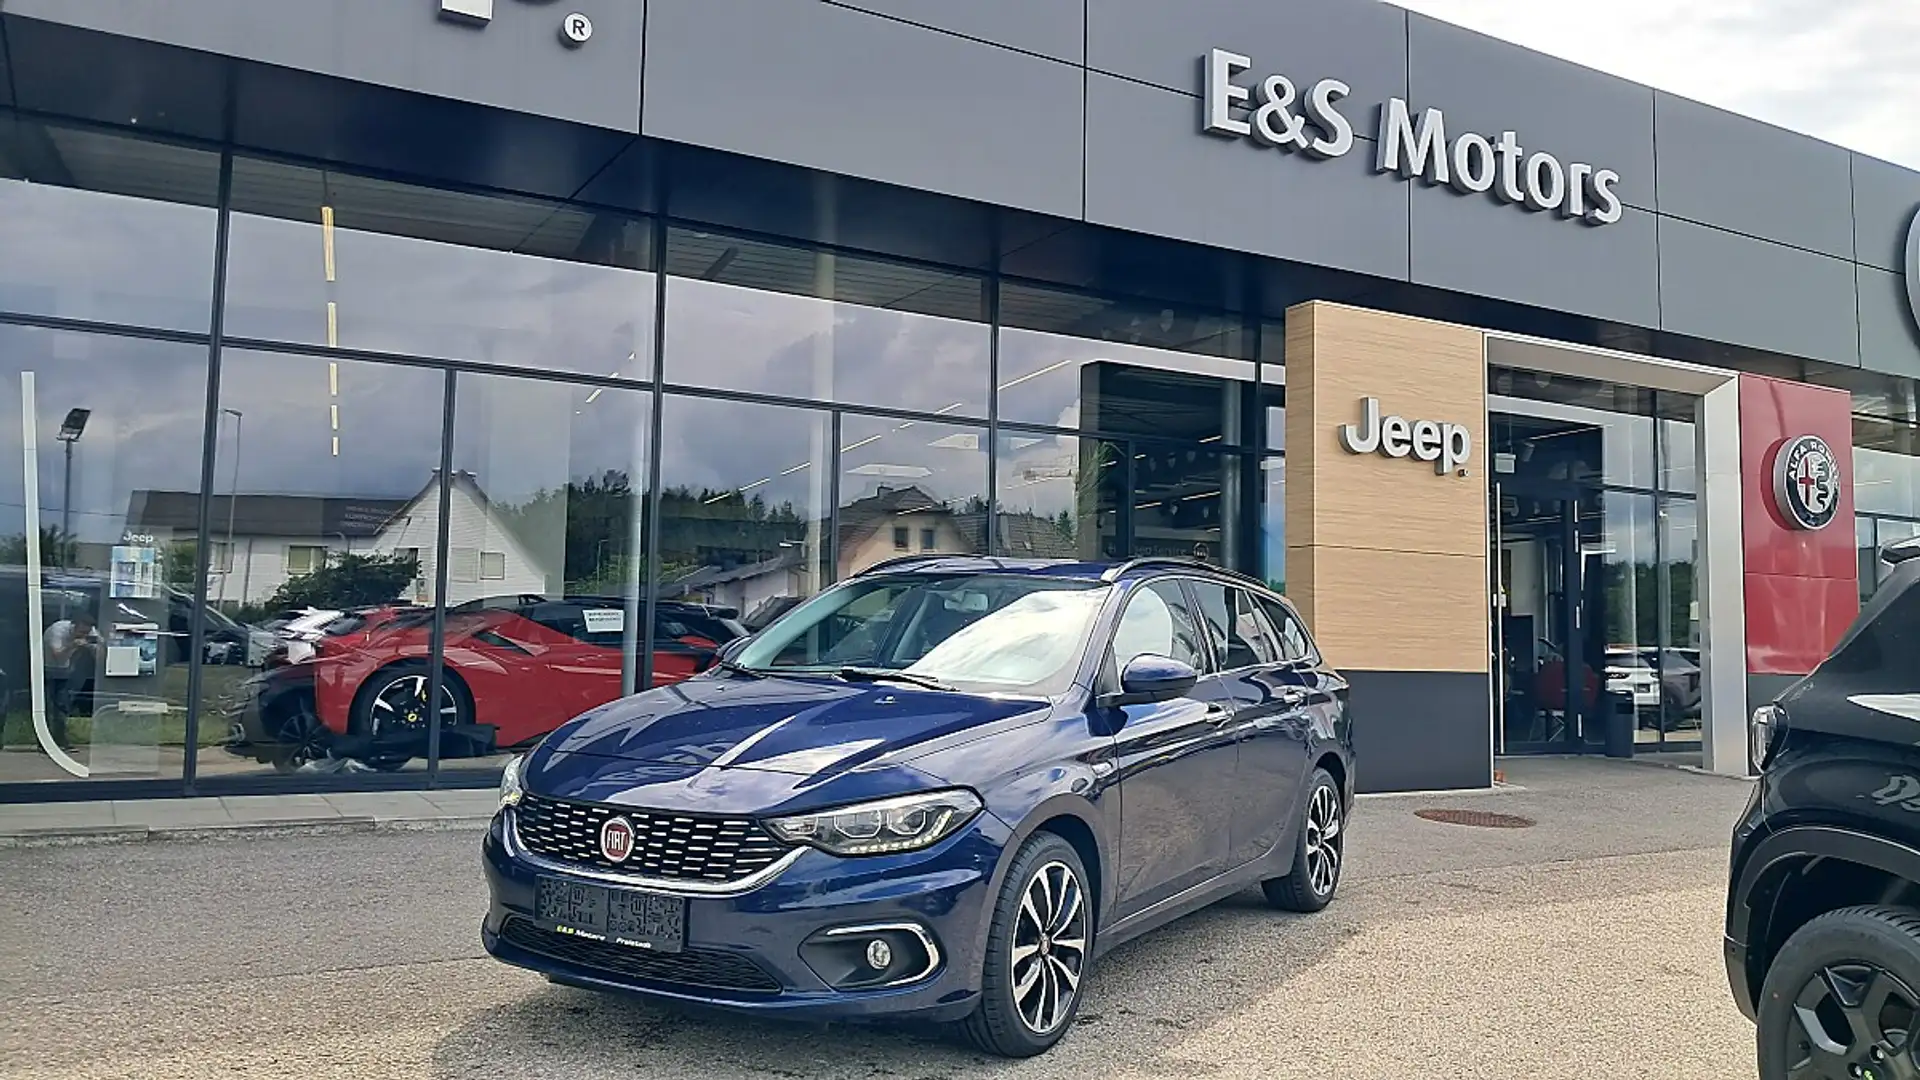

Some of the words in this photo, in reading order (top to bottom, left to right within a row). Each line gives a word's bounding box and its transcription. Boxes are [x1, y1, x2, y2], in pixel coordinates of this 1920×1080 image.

[1207, 48, 1354, 157] E&S
[1379, 97, 1623, 224] Motors
[1340, 396, 1471, 475] Jeep
[1789, 445, 1808, 480] ALFA
[123, 531, 154, 543] Jeep
[606, 830, 627, 851] FIAT
